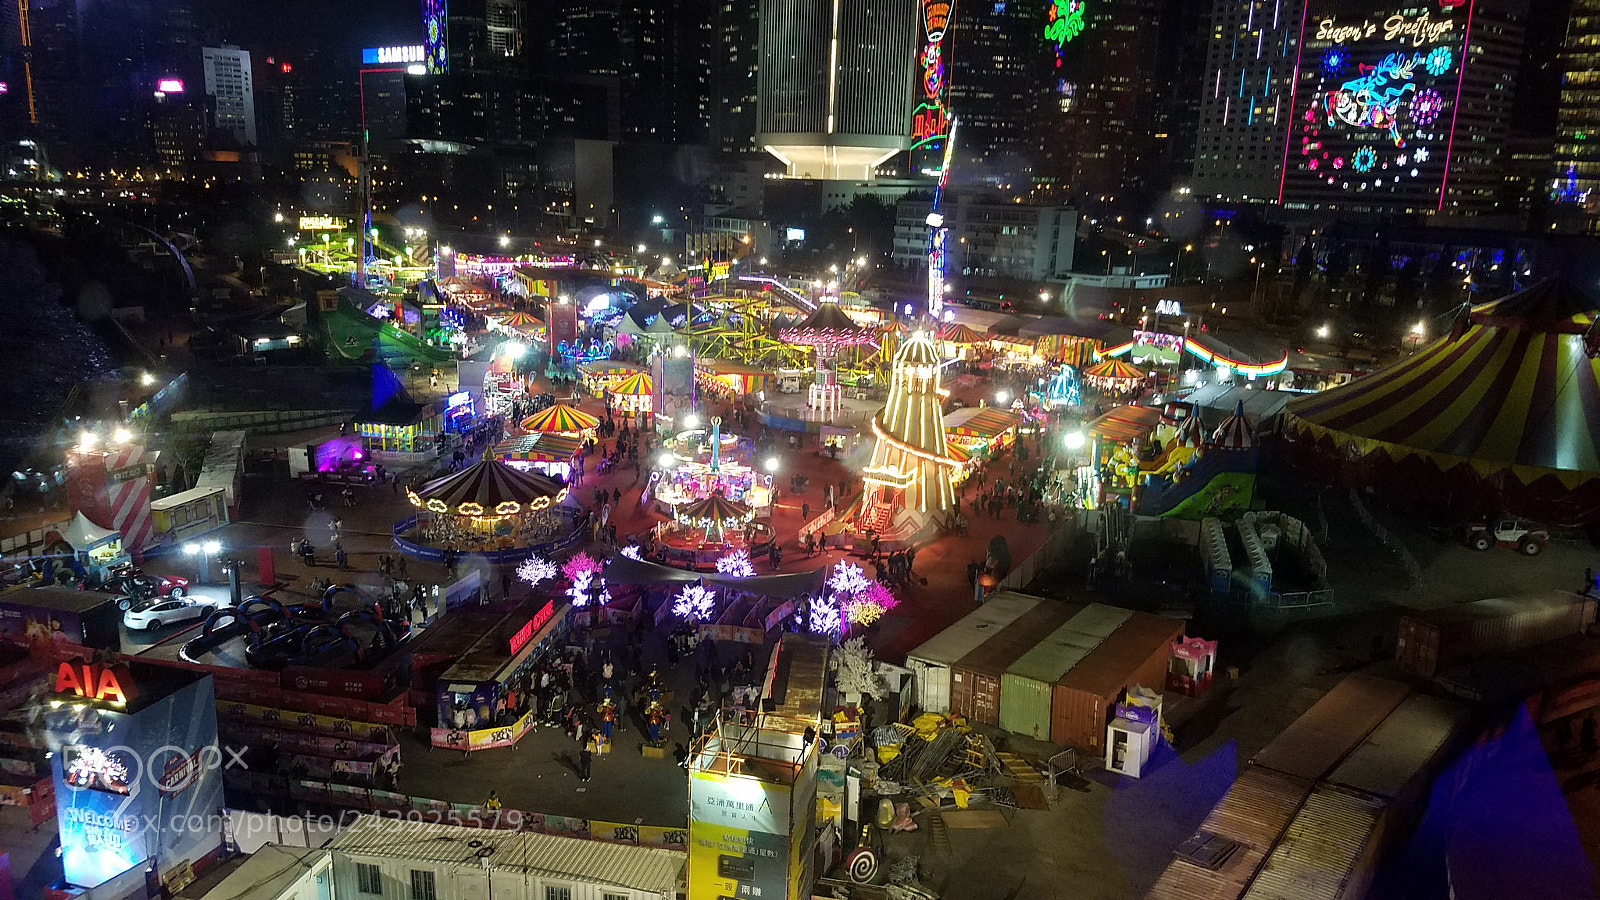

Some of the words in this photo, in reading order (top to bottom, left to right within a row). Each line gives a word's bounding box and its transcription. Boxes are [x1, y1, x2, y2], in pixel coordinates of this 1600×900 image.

[1316, 19, 1376, 43] Season's
[1383, 11, 1454, 47] Greetings
[378, 45, 425, 63] SAMSUN
[1155, 299, 1181, 316] AIA
[55, 662, 127, 702] AIA
[165, 759, 198, 789] CARNIVAL
[69, 807, 132, 832] WELCOME
